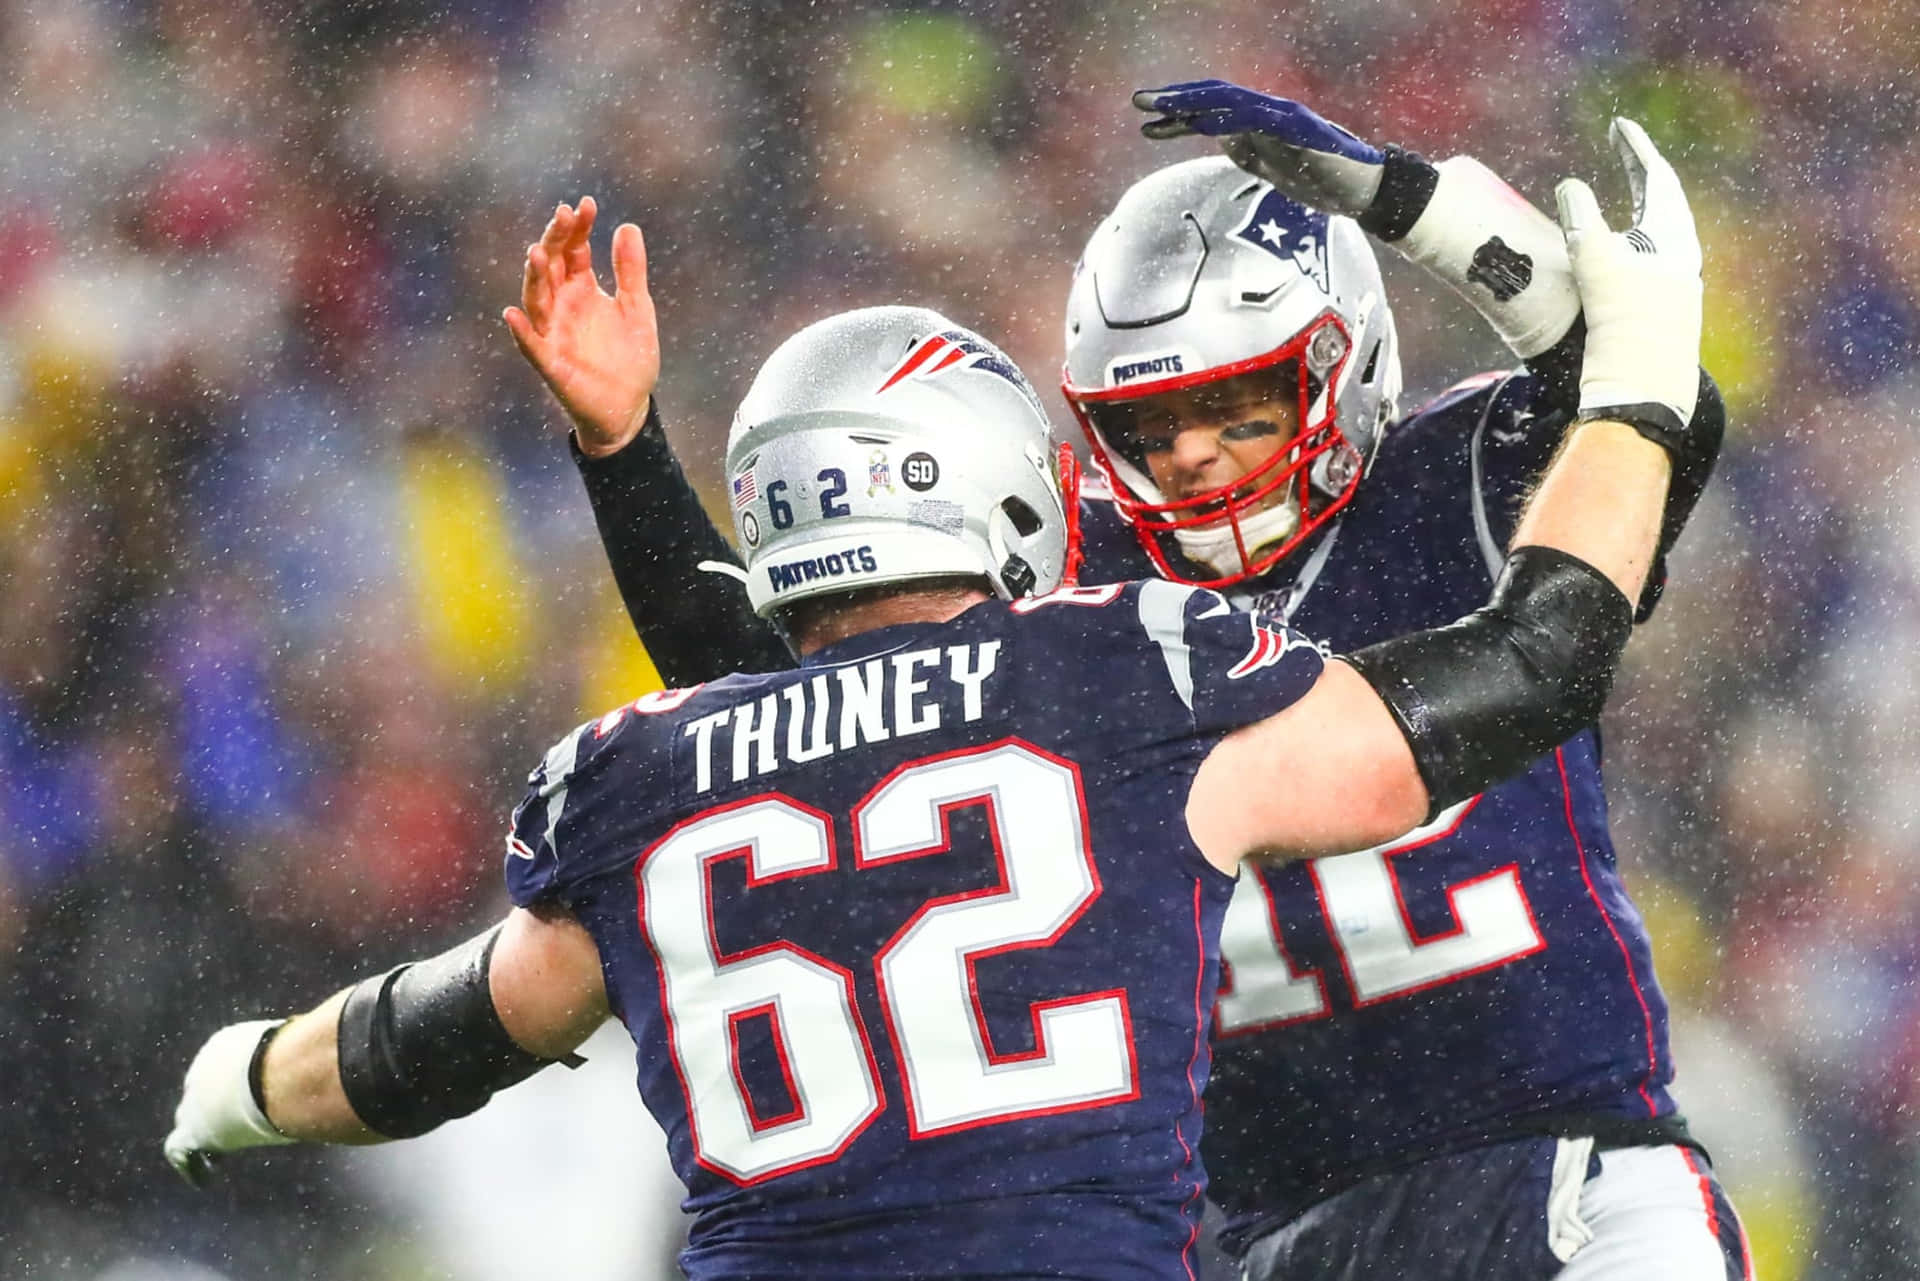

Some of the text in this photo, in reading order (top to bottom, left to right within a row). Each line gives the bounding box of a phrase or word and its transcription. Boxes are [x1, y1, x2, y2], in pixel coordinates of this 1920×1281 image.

[1112, 354, 1184, 385] PATRIOTS
[907, 460, 933, 483] SD
[767, 545, 878, 593] PATRIOTS
[684, 639, 1001, 794] THUNEY
[635, 735, 1141, 1188] 62
